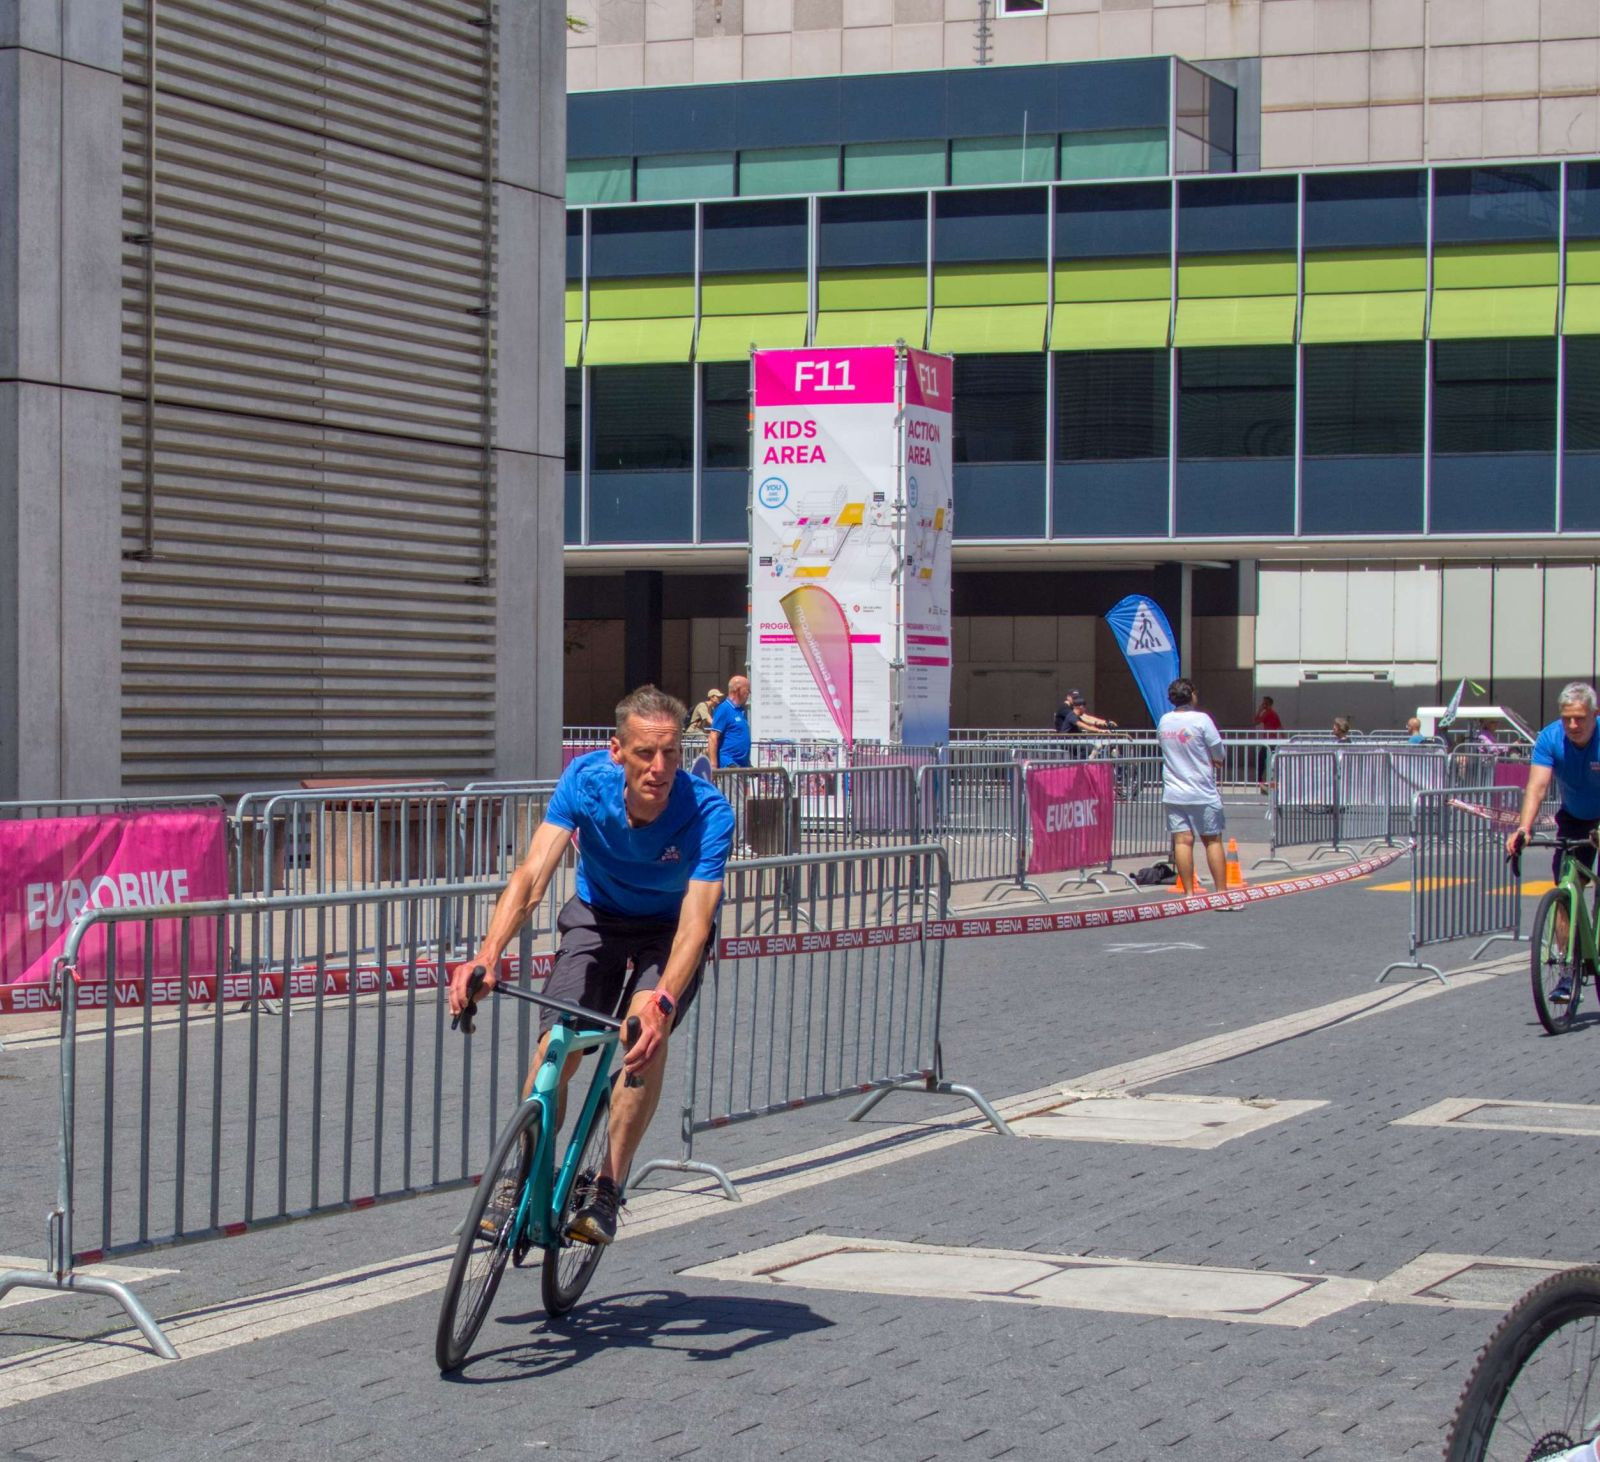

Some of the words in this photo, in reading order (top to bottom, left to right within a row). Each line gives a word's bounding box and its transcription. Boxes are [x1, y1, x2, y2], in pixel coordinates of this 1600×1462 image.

[795, 360, 855, 391] F11
[918, 363, 939, 397] F11
[764, 420, 817, 439] KIDS
[908, 420, 940, 443] ACTION
[763, 445, 826, 464] AREA
[908, 445, 931, 466] AREA
[28, 869, 188, 931] EUROBIKE
[510, 957, 551, 978] SNA
[726, 940, 760, 956] SENA
[766, 938, 797, 953] SENA
[802, 935, 830, 950] SENA
[836, 932, 863, 947] SENA
[868, 929, 894, 944] SENA
[925, 922, 957, 937] SENA
[962, 921, 991, 935] SENA
[995, 919, 1023, 933] SENA
[1027, 917, 1053, 931] SENA
[1057, 914, 1082, 928] SENA
[1085, 911, 1110, 926] SENA
[1112, 908, 1136, 923] SENA
[1138, 905, 1160, 920] SENA
[1162, 901, 1185, 916] SENA
